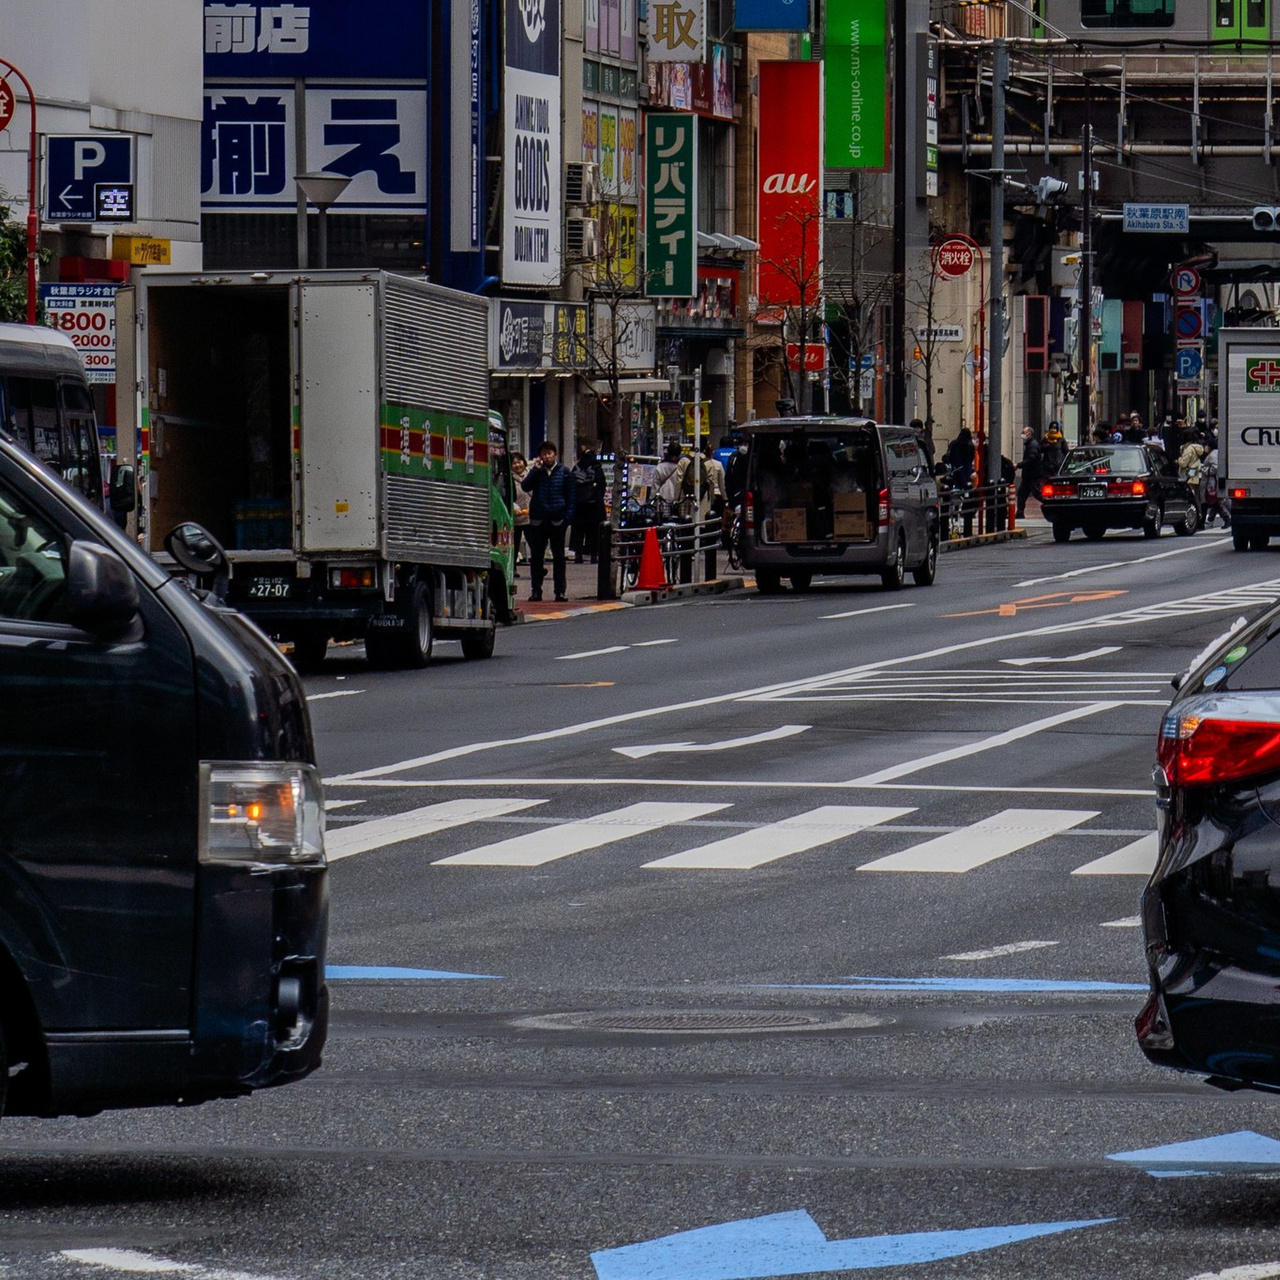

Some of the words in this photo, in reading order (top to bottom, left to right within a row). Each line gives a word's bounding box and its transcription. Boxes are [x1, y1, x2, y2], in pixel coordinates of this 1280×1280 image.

[205, 3, 310, 54] 前店
[849, 18, 861, 159] www.ms-online.co.jp
[74, 140, 106, 180] P
[514, 134, 550, 213] GOODS
[763, 172, 816, 194] au
[99, 188, 130, 216] 空
[653, 126, 686, 286] リバティー
[1126, 207, 1186, 220] 秋葉原駅南
[1126, 220, 1161, 229] Akihabara
[941, 251, 971, 266] 消火栓
[50, 312, 106, 331] 1800
[71, 334, 111, 347] 2000
[85, 355, 110, 365] 300
